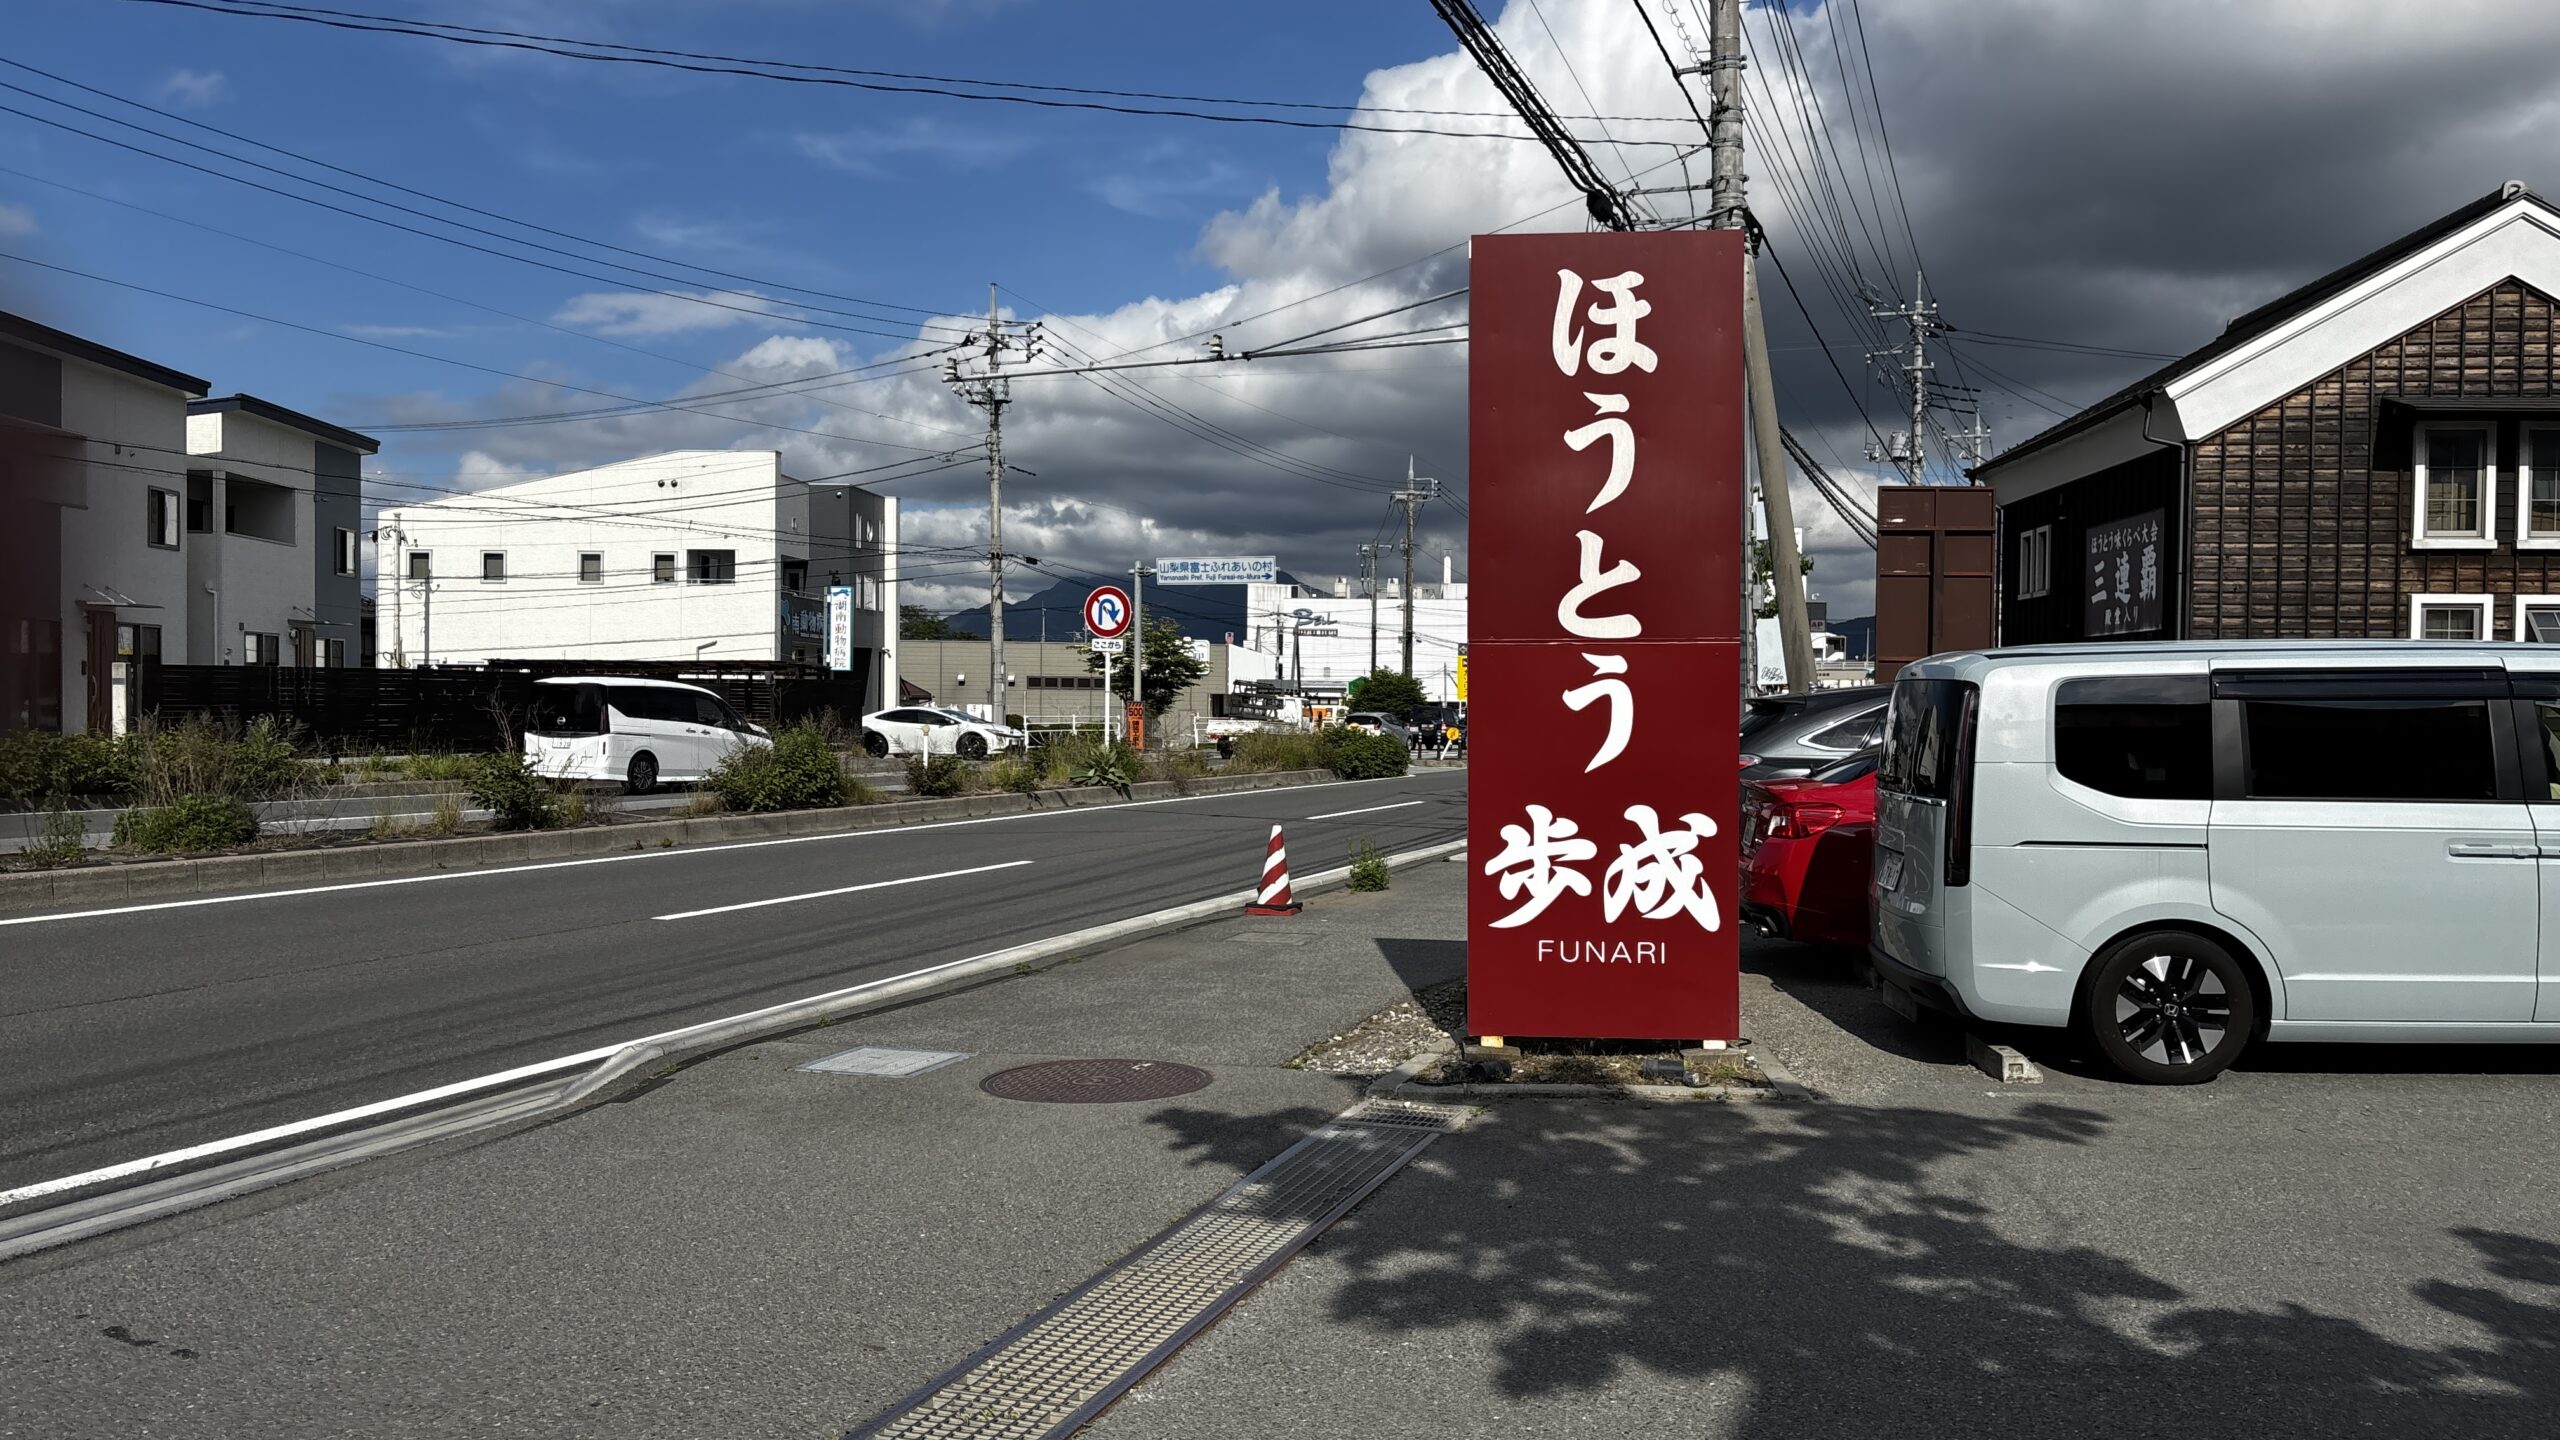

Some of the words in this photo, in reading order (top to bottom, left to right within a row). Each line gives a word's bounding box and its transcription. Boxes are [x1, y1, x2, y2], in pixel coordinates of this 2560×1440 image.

[1552, 268, 1658, 774] ほうとう
[2091, 520, 2158, 554] ほうとう味くらべ大会
[1160, 561, 1273, 574] 山梨県富士ふれあいの村
[2091, 544, 2157, 604] 三連覇
[834, 599, 847, 668] 湖南動物病院
[1094, 641, 1122, 649] ここから
[1128, 707, 1143, 716] 500
[1538, 939, 1666, 964] FUNARI
